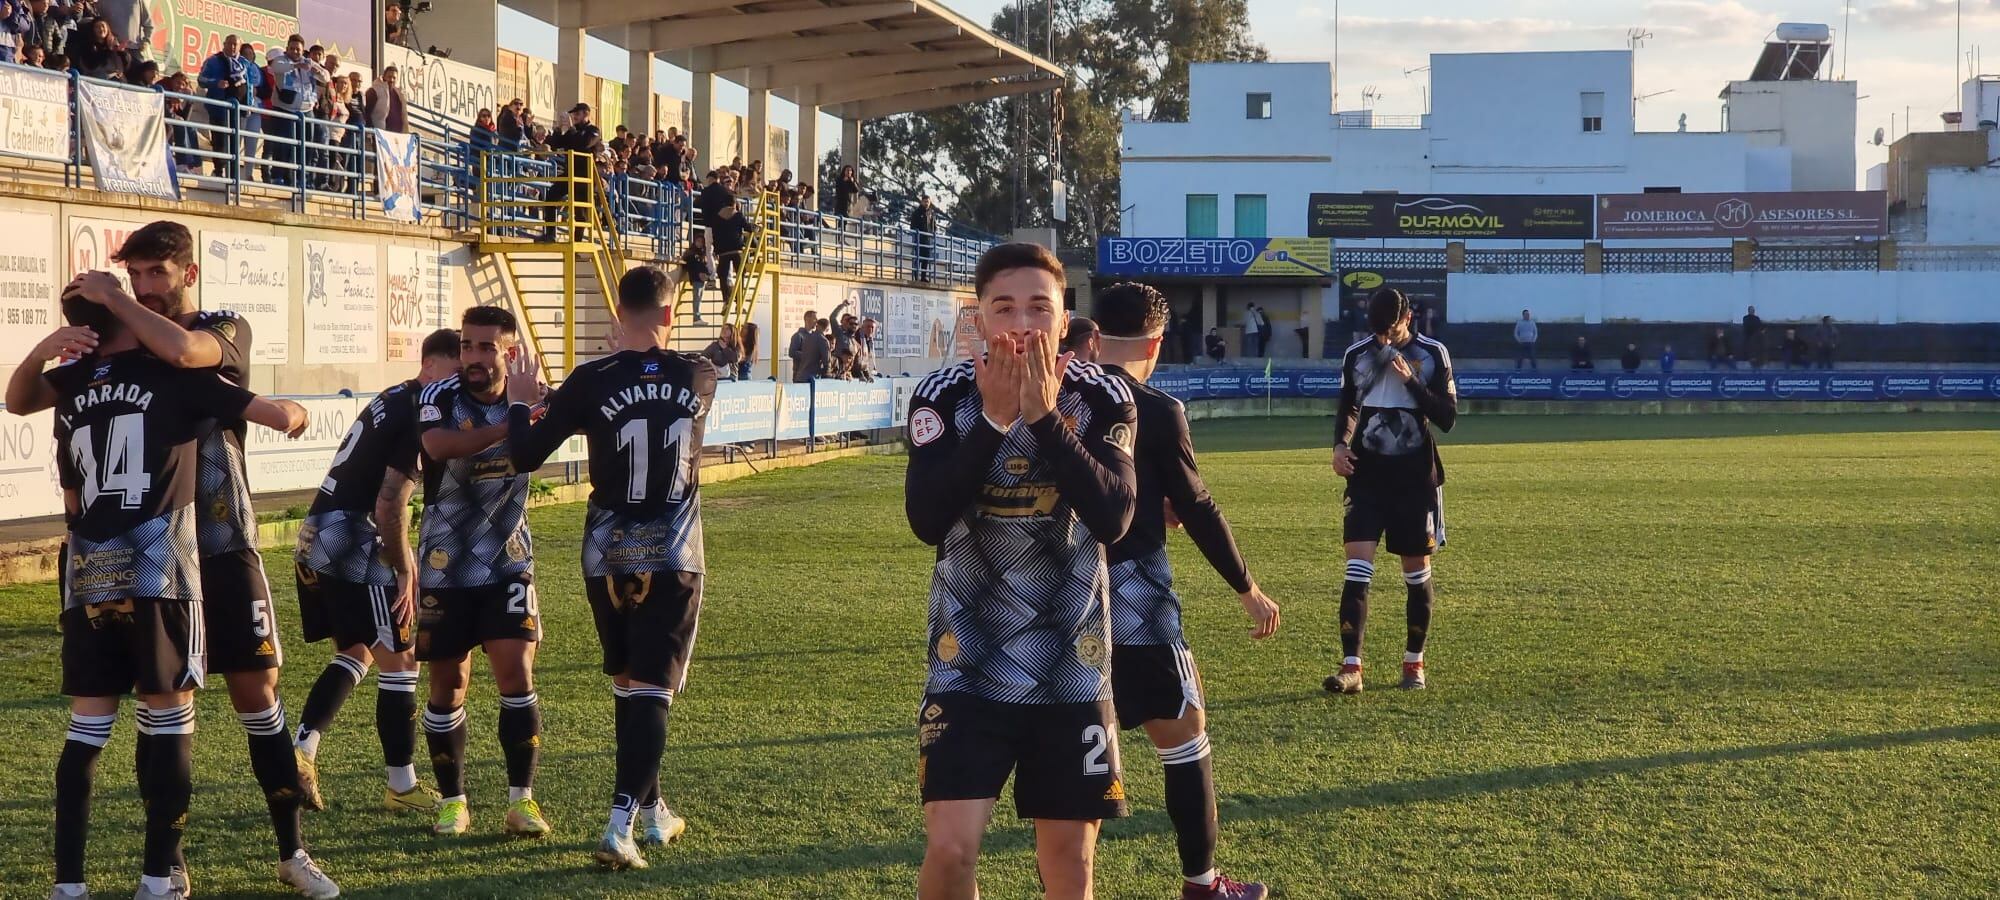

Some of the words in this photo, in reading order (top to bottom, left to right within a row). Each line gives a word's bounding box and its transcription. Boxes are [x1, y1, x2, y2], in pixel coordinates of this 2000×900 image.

[177, 0, 296, 41] SUPERMERCADOS
[450, 77, 493, 119] BARCO
[1400, 212, 1504, 228] DURMÓVIL
[1623, 210, 1706, 221] JOMEROCA
[1759, 208, 1835, 220] ASESORES
[1108, 238, 1254, 264] BOZETO
[1143, 265, 1220, 273] creativo
[7, 308, 20, 324] 955
[256, 303, 277, 313] GENERAL
[863, 289, 882, 314] Toldos
[74, 383, 153, 413] PARADA
[600, 383, 673, 421] ALVARO
[70, 413, 151, 518] 14
[616, 417, 693, 504] 11
[507, 582, 539, 617] 20
[251, 599, 270, 638] 5
[1081, 723, 1121, 776] 21
